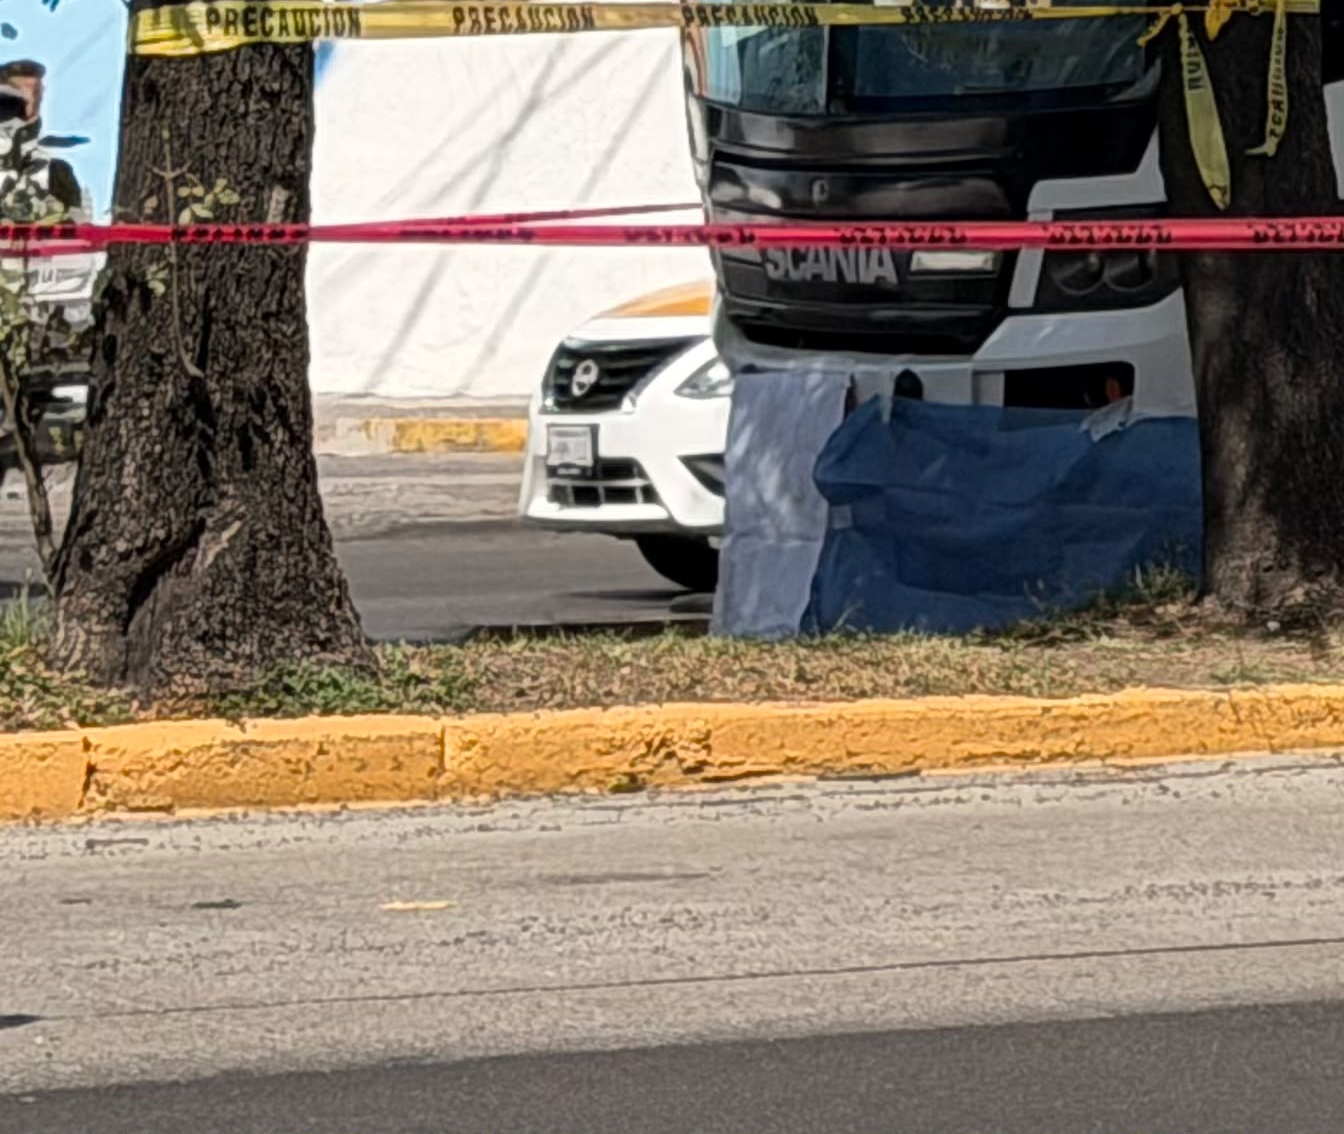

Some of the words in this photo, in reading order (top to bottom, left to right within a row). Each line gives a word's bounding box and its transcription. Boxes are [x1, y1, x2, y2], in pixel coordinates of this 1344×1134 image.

[205, 7, 361, 39] PRECAUCION
[451, 4, 597, 33] PRECAUCION
[681, 4, 819, 27] PRECAUCION
[766, 246, 899, 285] SCANIA
